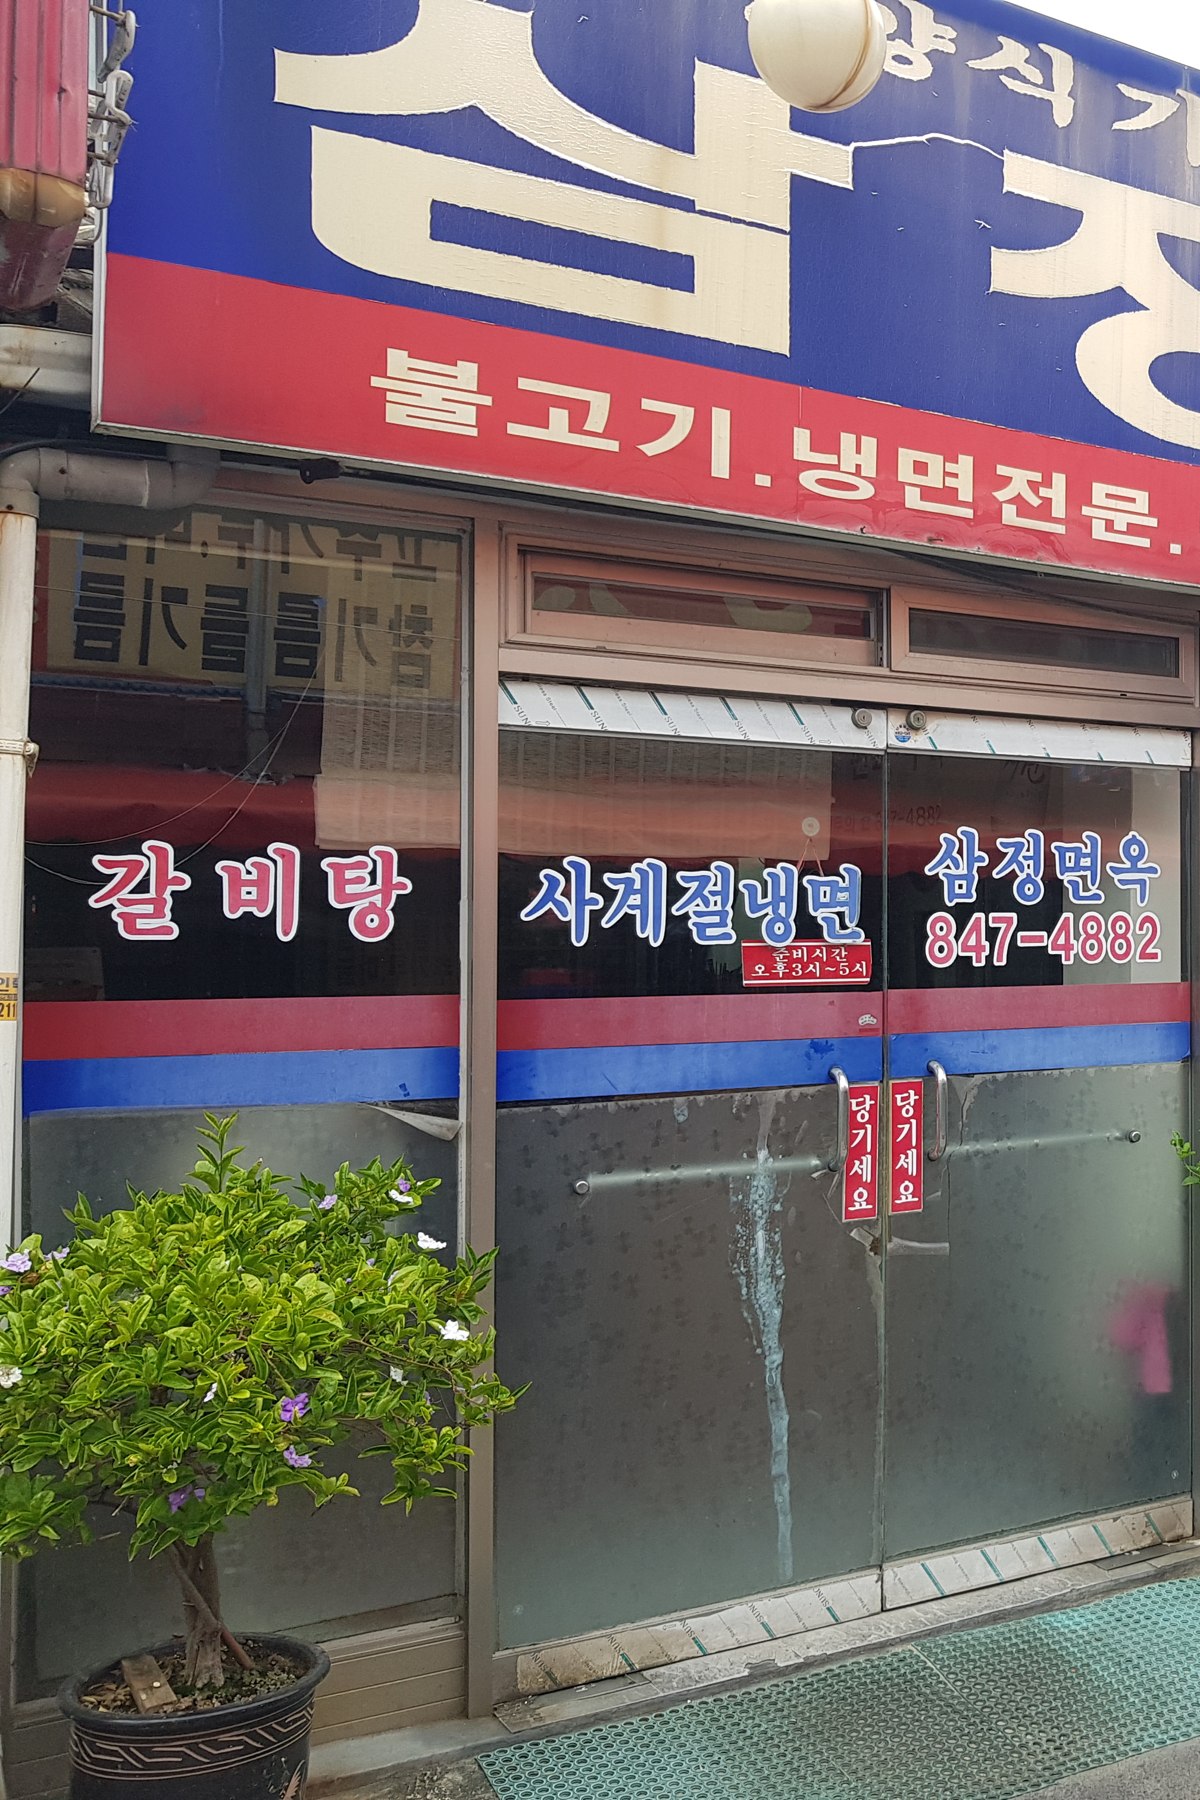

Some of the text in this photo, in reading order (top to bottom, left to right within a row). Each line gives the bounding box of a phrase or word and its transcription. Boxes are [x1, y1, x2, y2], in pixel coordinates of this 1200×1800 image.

[88, 840, 412, 942] 갈비탕
[520, 855, 866, 947] 사계절냉면
[925, 825, 1161, 906] 삼정면옥
[926, 911, 1162, 968] 847-4882
[848, 1094, 875, 1211] 당기세요
[894, 1089, 920, 1204] 당기세요
